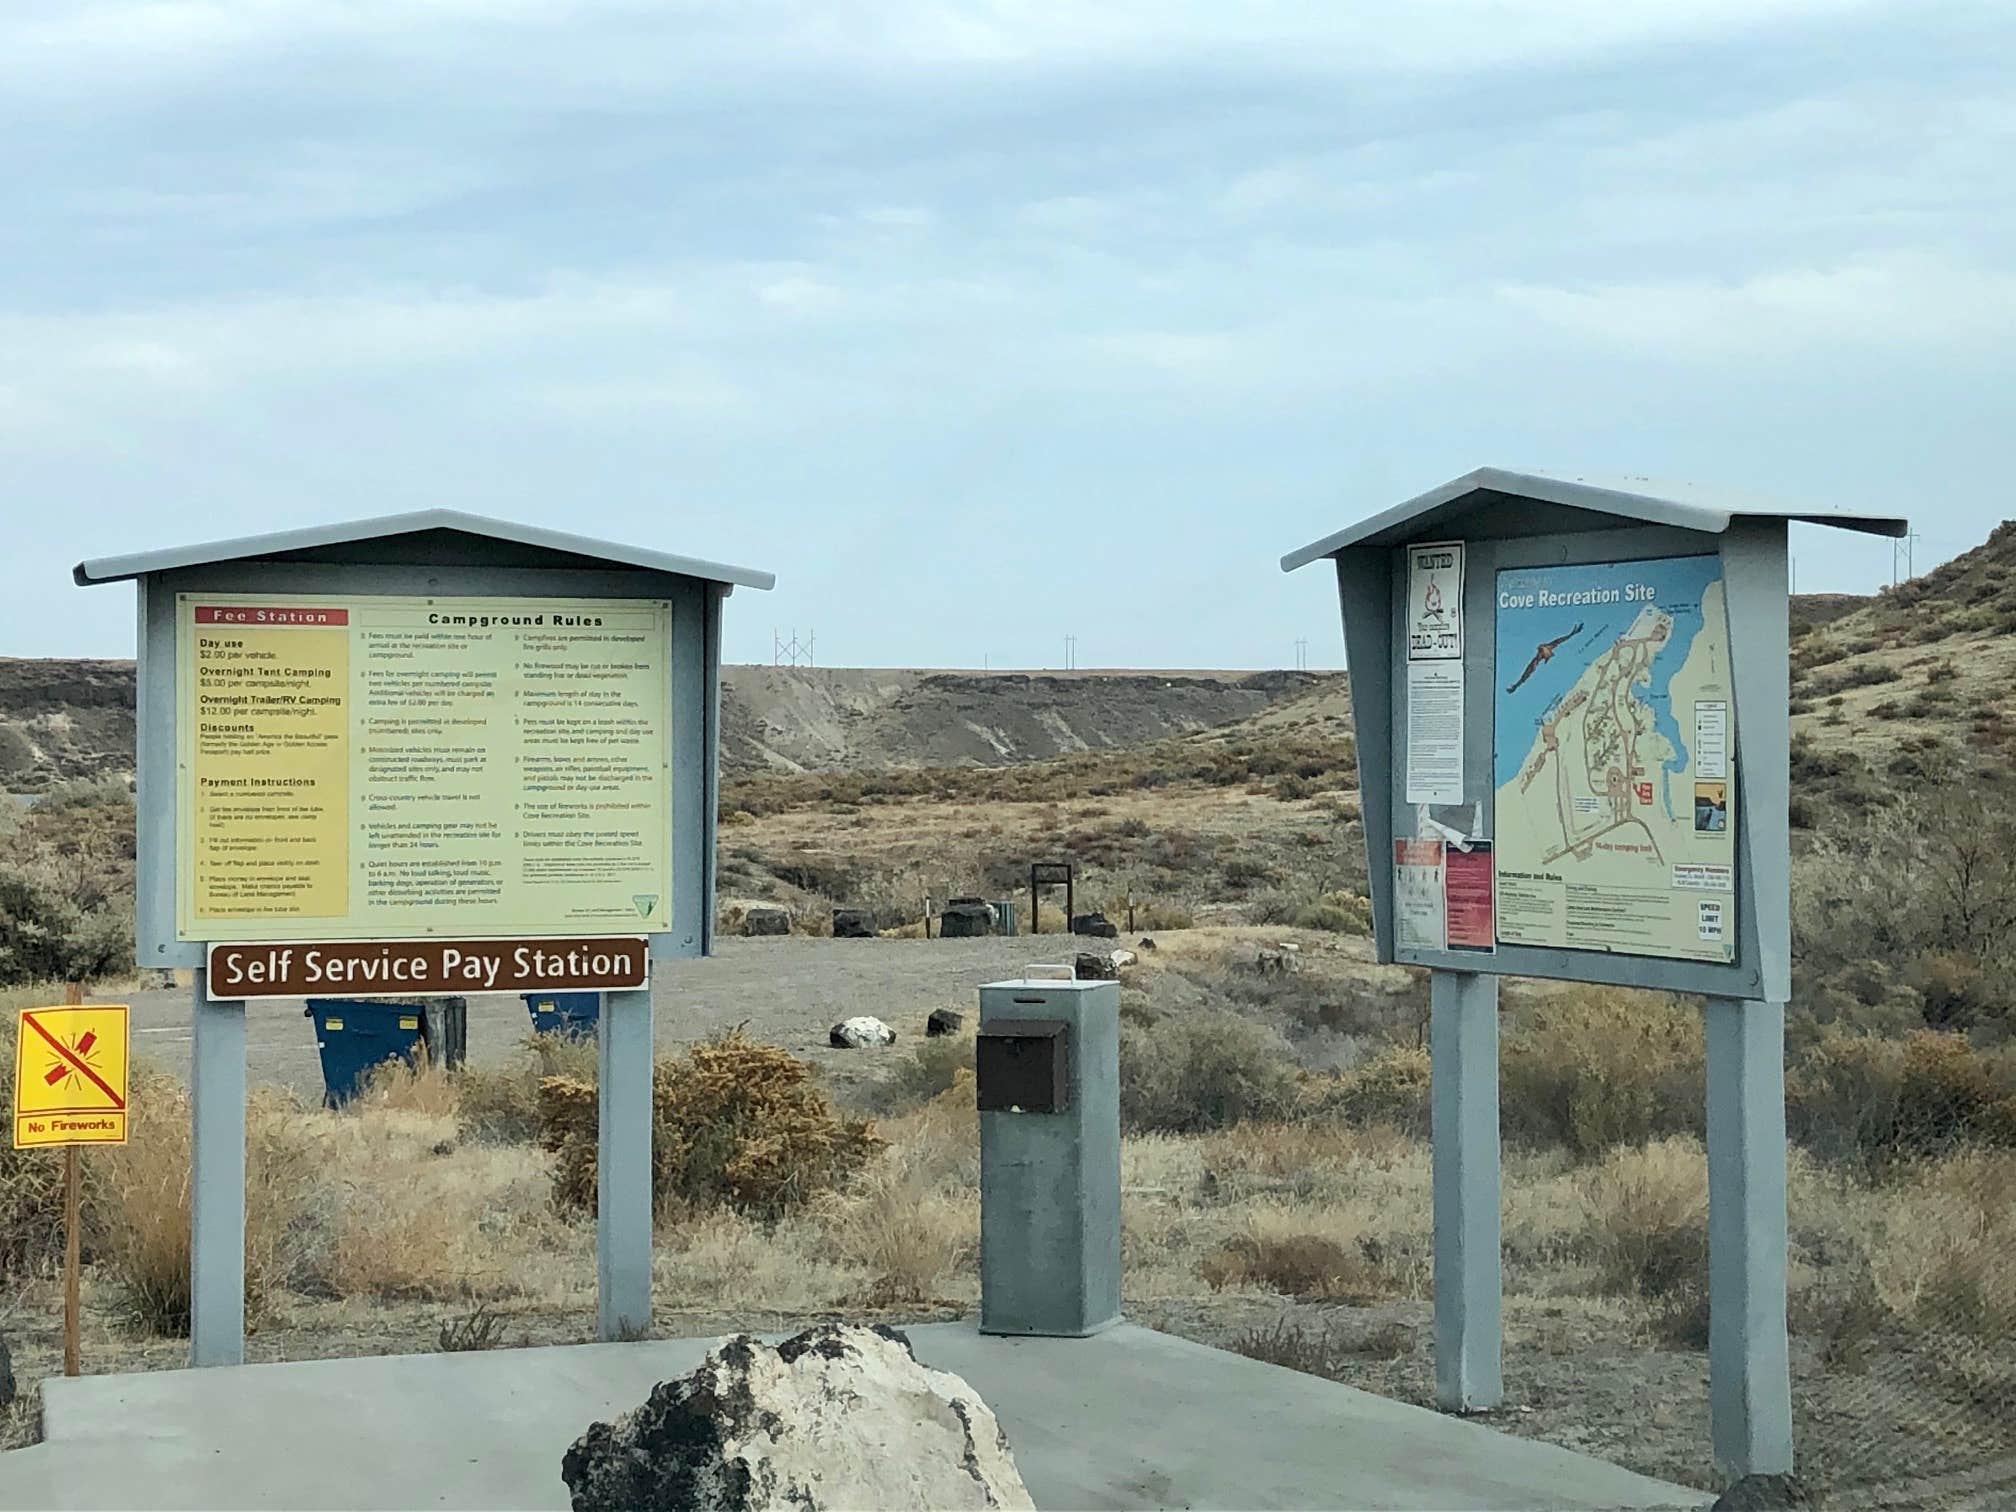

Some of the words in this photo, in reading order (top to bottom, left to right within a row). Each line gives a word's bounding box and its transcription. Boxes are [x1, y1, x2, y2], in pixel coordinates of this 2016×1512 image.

[1500, 593, 1533, 608] Cove
[1539, 587, 1619, 606] Recreation
[1625, 583, 1656, 601] Site
[214, 610, 246, 621] Fee
[257, 610, 327, 621] Station
[428, 614, 543, 626] Campground
[554, 616, 602, 626] Rules
[200, 639, 220, 649] Day
[200, 667, 253, 677] Overnight
[284, 668, 331, 678] Camping
[200, 695, 247, 705] Overnight
[251, 696, 296, 704] Trailer/RV
[299, 696, 341, 705] Camping
[200, 723, 254, 732] Discounts
[200, 778, 247, 787] Payment
[251, 778, 316, 786] Instructions
[226, 949, 293, 984] Self
[305, 948, 428, 982] Service
[442, 948, 500, 987] Pay
[513, 944, 631, 978] Station
[28, 1122, 45, 1133] No
[51, 1119, 115, 1131] Fireworks
